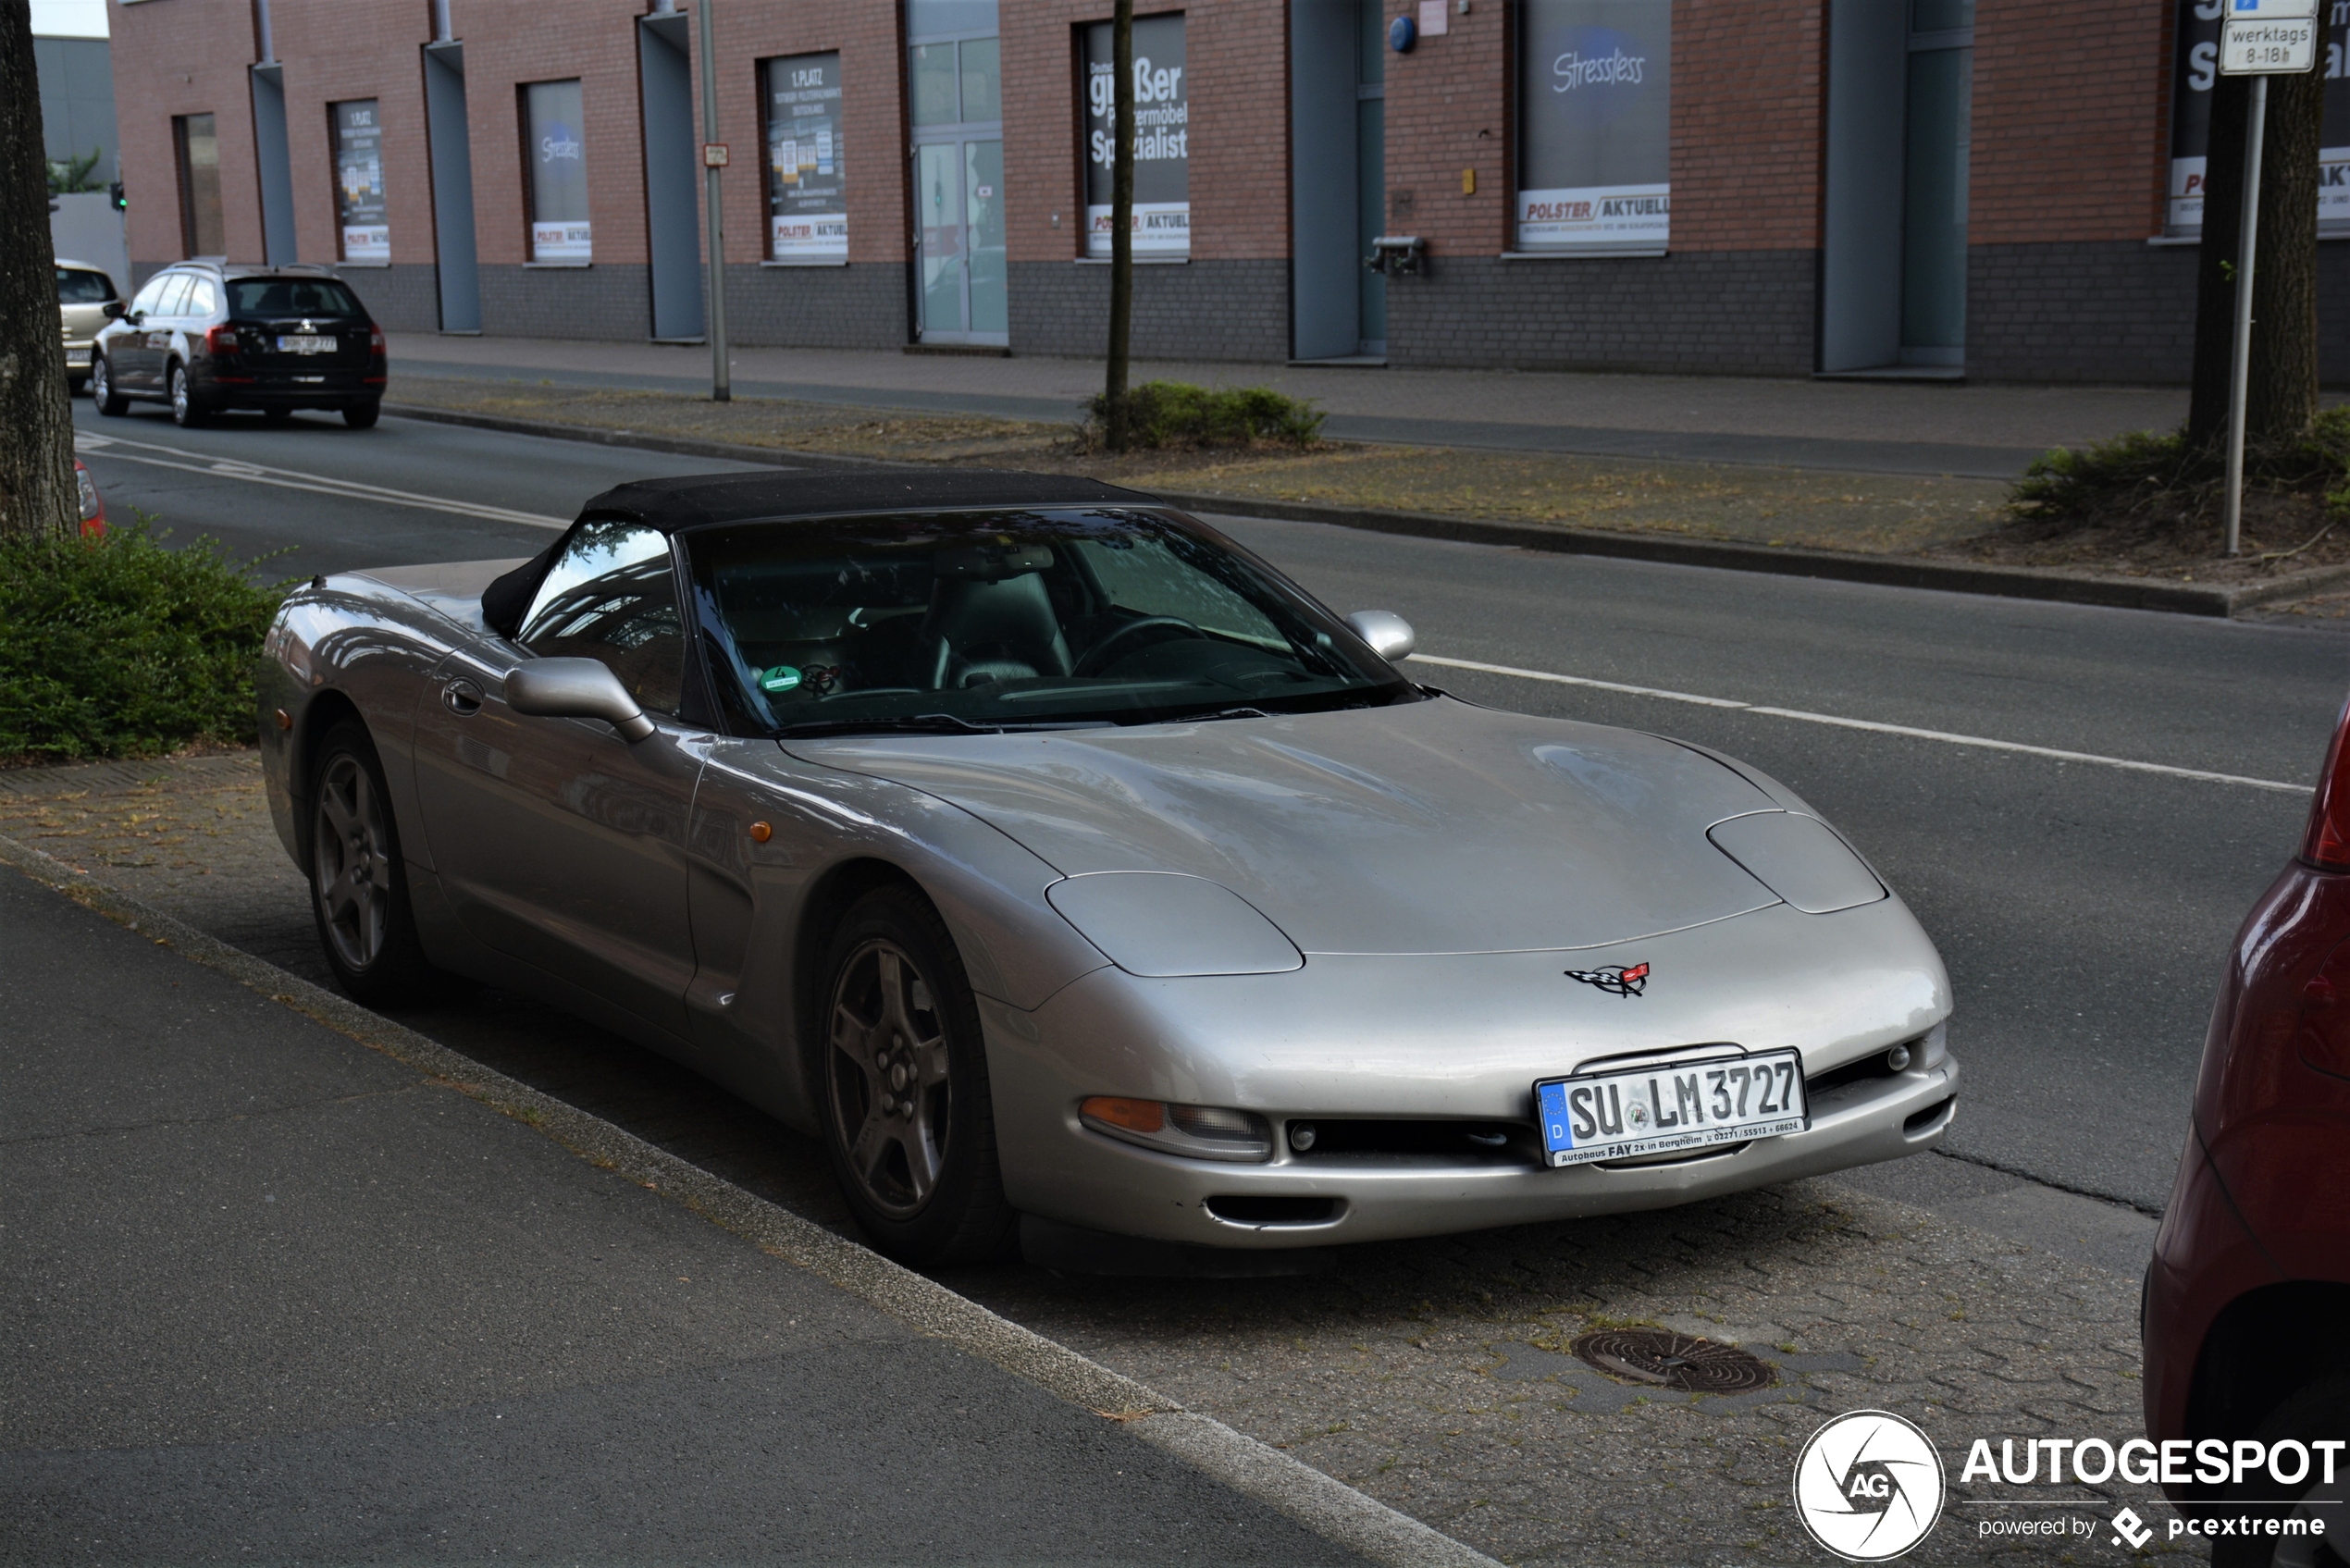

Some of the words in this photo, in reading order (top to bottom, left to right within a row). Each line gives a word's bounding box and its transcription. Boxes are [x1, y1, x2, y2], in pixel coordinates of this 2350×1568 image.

[2232, 27, 2308, 44] werktags
[1552, 47, 1646, 93] Stressless
[1090, 56, 1182, 117] grßer
[1527, 201, 1591, 220] POLSTER
[1602, 197, 1670, 216] AKTUELL
[817, 224, 847, 236] AKTUEL
[1146, 213, 1190, 229] AKTUEL
[773, 667, 786, 678] 4
[1570, 1083, 1624, 1140] SU
[1649, 1073, 1703, 1129] LM
[1706, 1061, 1795, 1120] 3727
[1553, 1124, 1564, 1139] D
[1562, 1150, 1606, 1163] Autohaus
[1608, 1144, 1632, 1157] FAY
[1648, 1142, 1657, 1151] in
[1659, 1136, 1702, 1148] Bergheim
